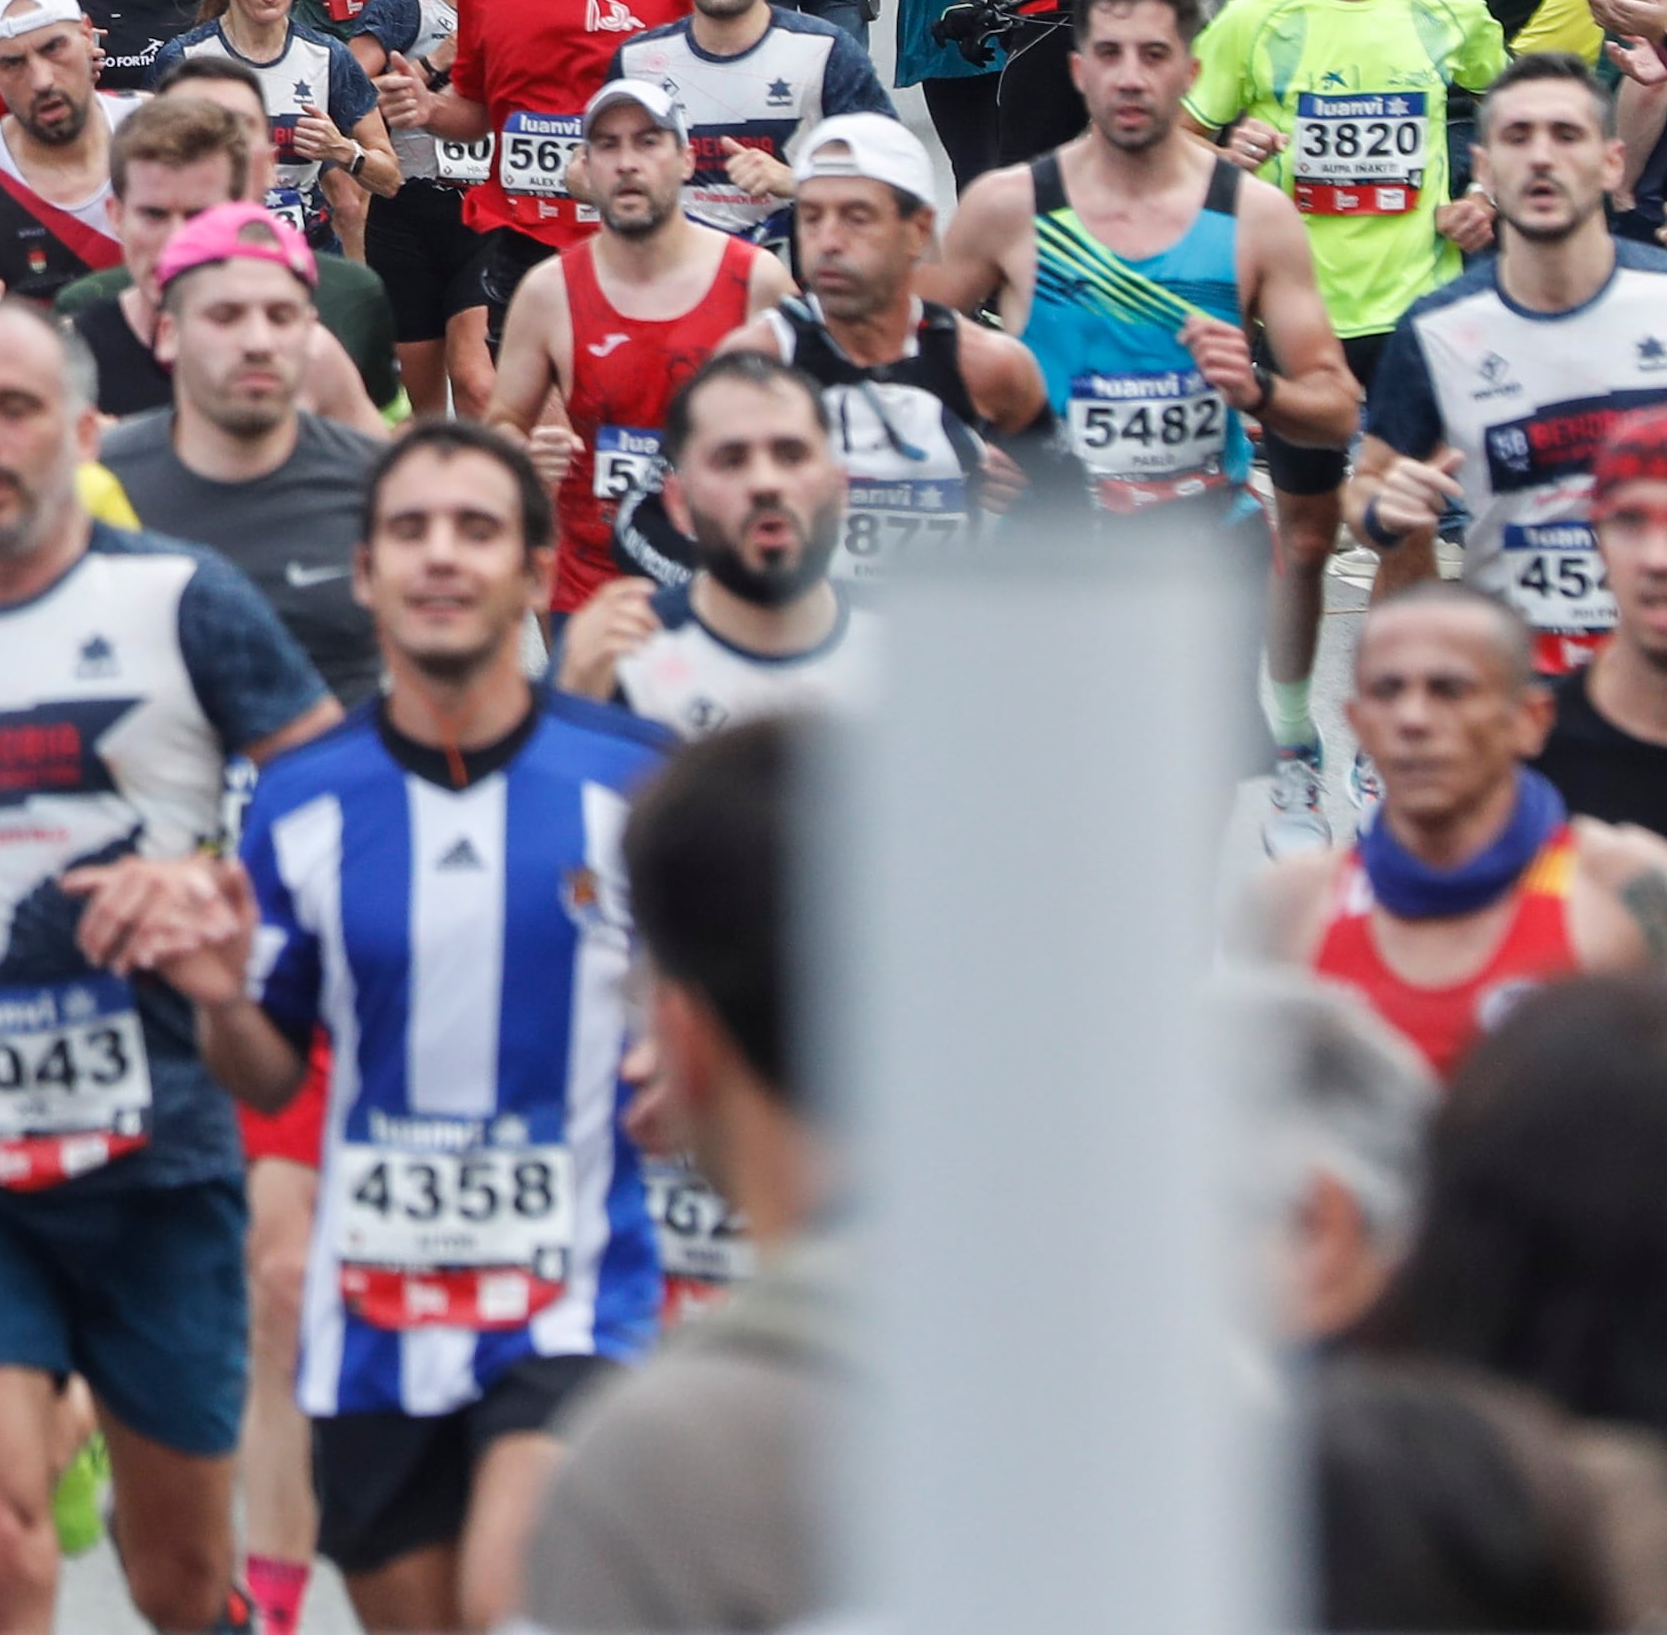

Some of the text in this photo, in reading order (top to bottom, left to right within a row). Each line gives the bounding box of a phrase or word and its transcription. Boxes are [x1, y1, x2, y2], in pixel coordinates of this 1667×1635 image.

[116, 54, 155, 68] FORTH
[1315, 96, 1386, 116] luanvi
[520, 115, 582, 135] luanvi
[1304, 123, 1422, 159] 3820
[529, 177, 555, 188] ALEX
[1095, 373, 1182, 399] luanvi
[1085, 399, 1223, 448] 5482
[354, 1159, 556, 1219] 4358
